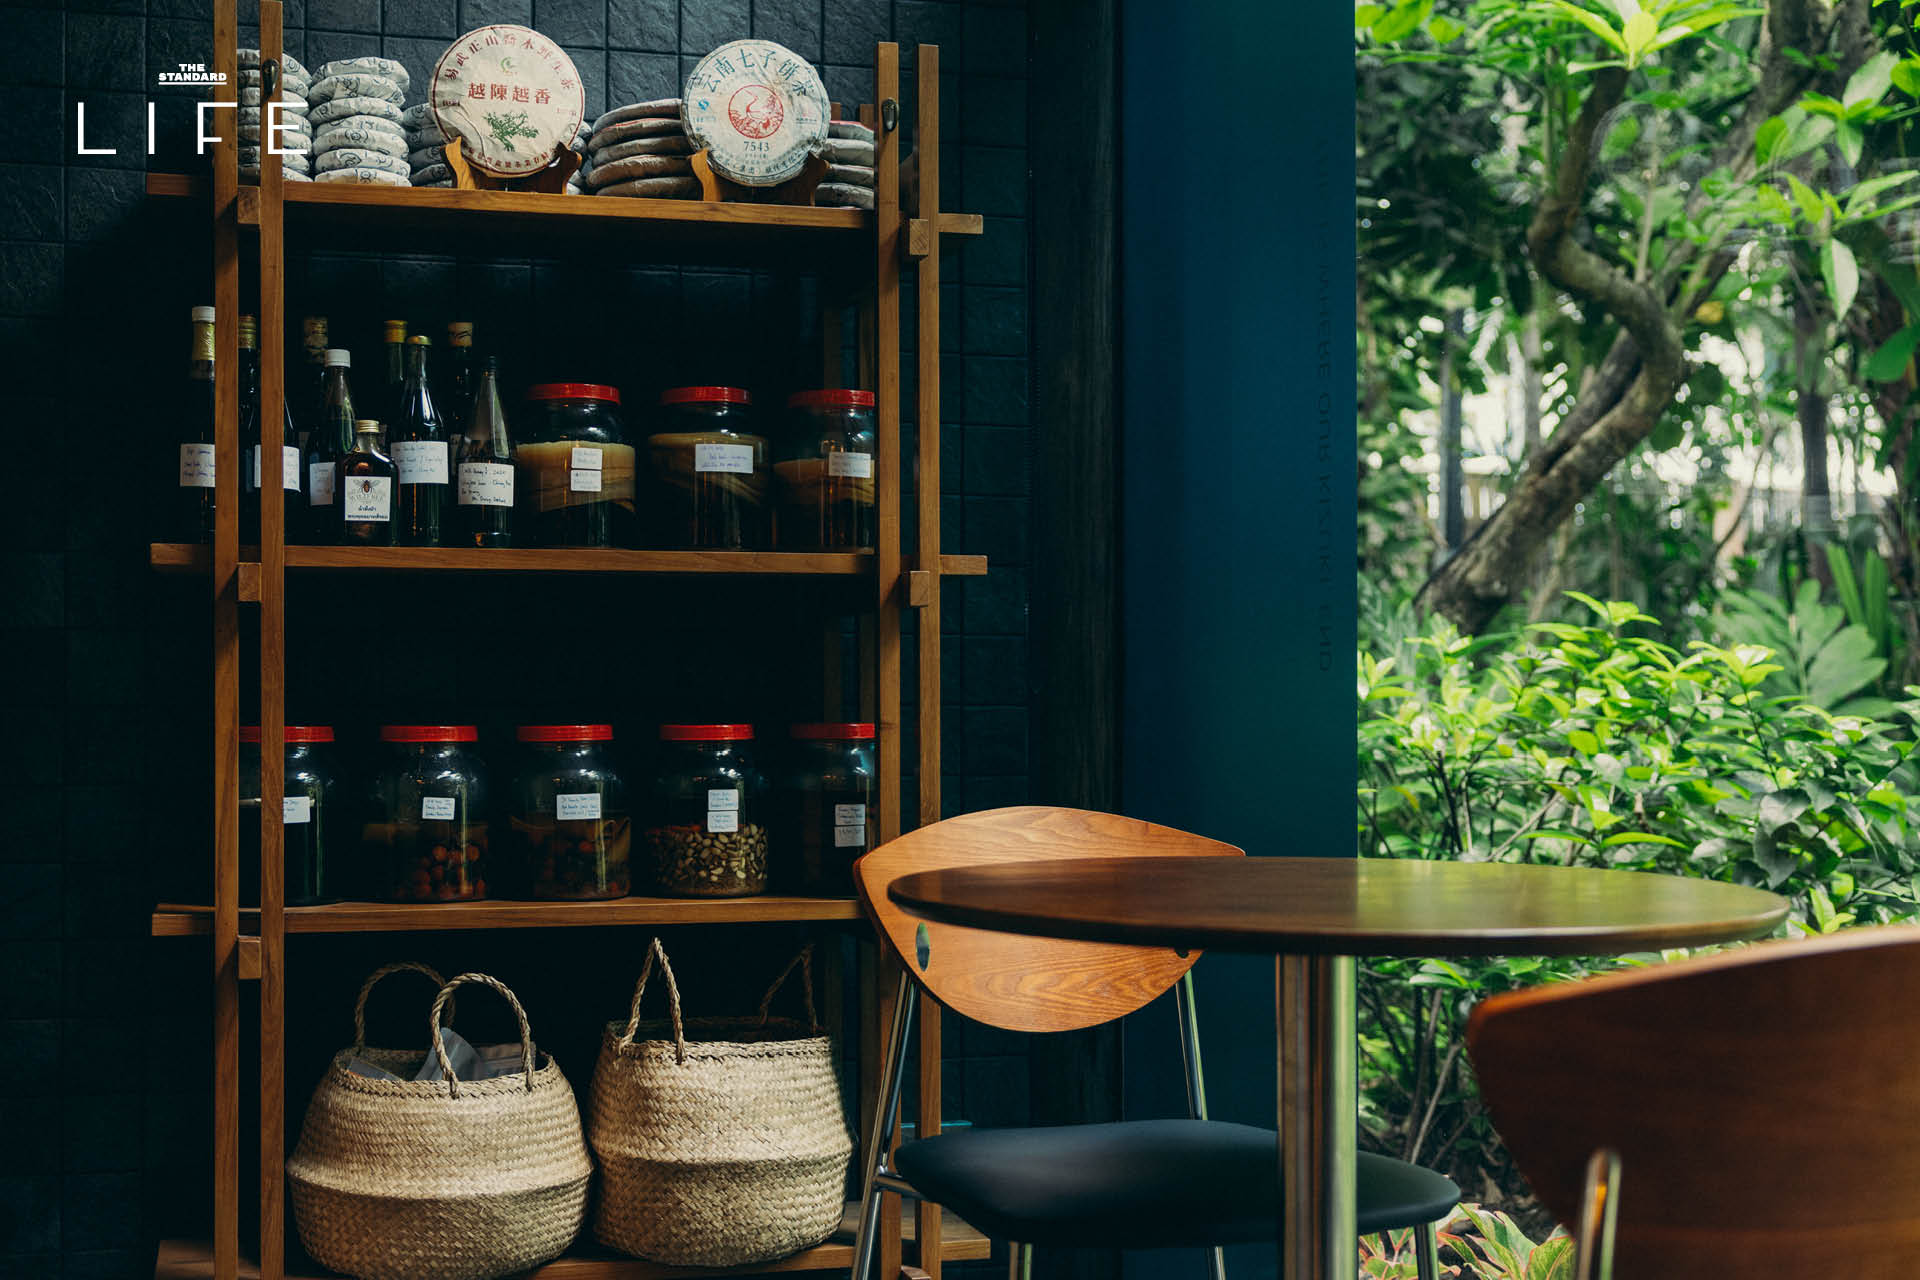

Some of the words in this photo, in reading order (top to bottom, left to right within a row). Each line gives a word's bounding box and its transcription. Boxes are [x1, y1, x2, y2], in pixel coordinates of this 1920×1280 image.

[467, 81, 552, 105] 越陳越香
[743, 140, 771, 153] 7543
